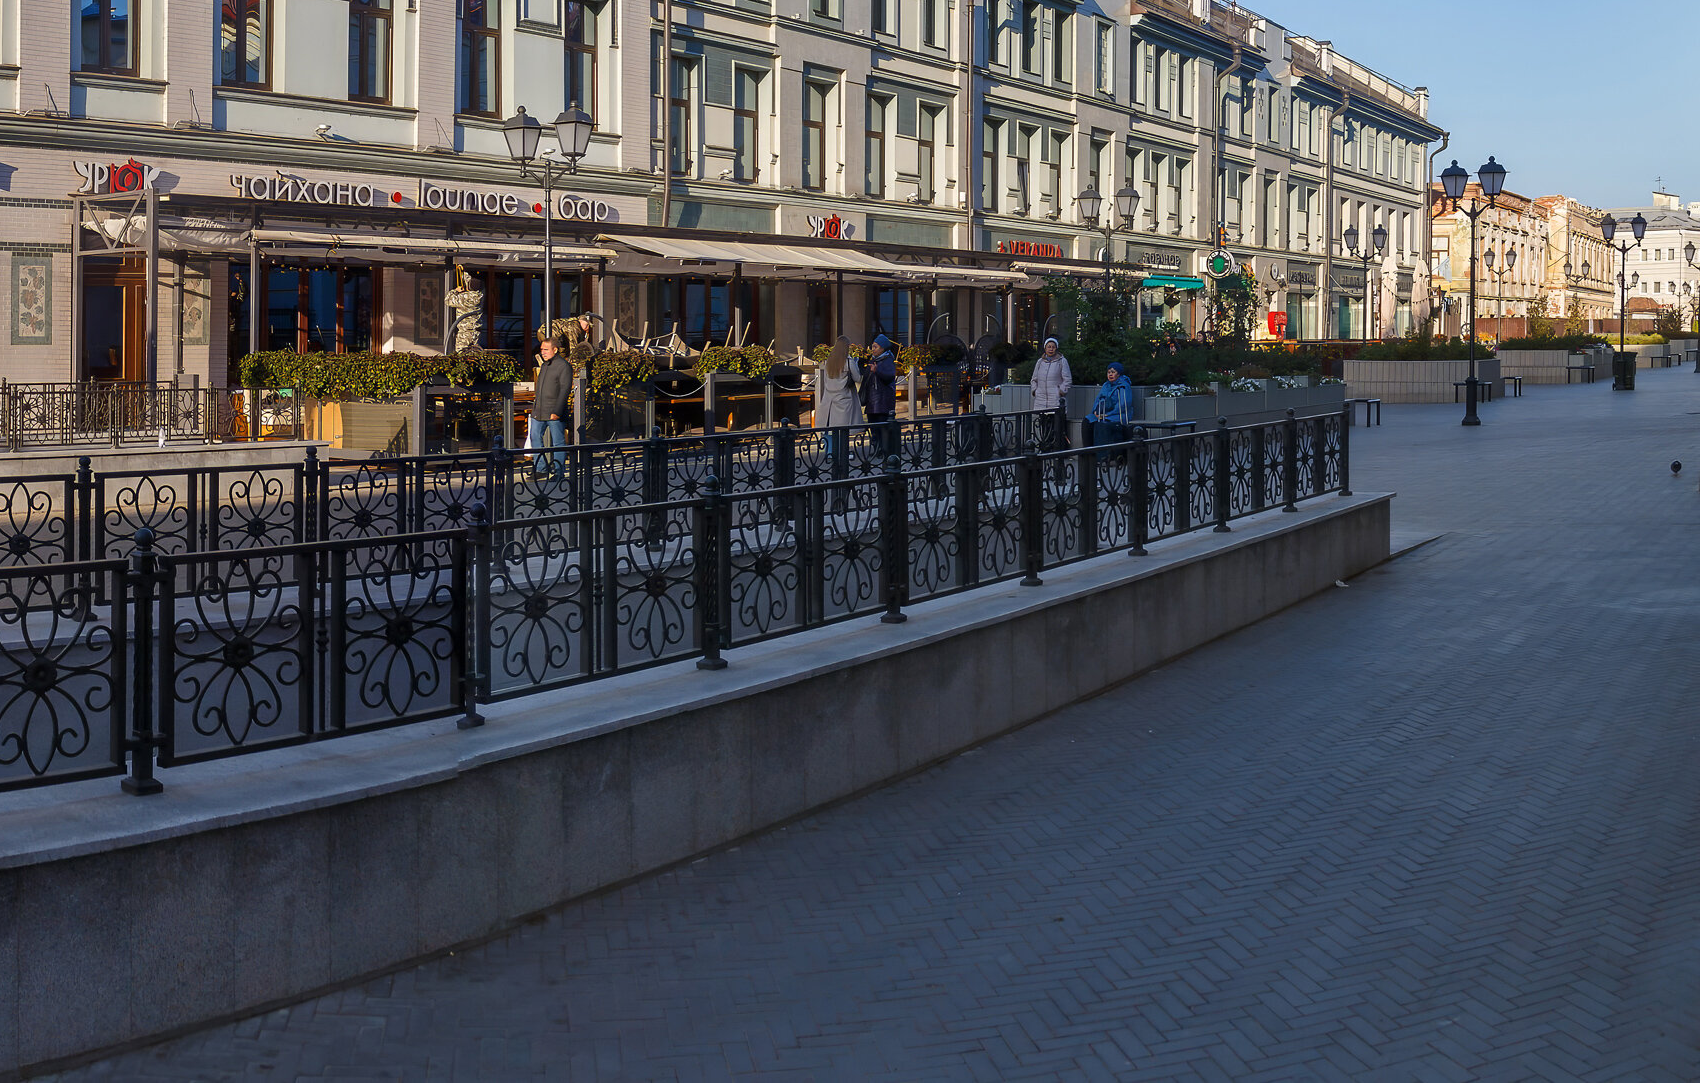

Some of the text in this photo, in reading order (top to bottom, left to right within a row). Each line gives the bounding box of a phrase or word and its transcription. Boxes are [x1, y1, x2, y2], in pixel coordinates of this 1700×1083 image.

[73, 157, 162, 194] УРЮК
[230, 169, 375, 207] чайхана
[558, 191, 609, 222] бар
[806, 214, 849, 240] УРЮК
[1009, 239, 1063, 259] VERANDA
